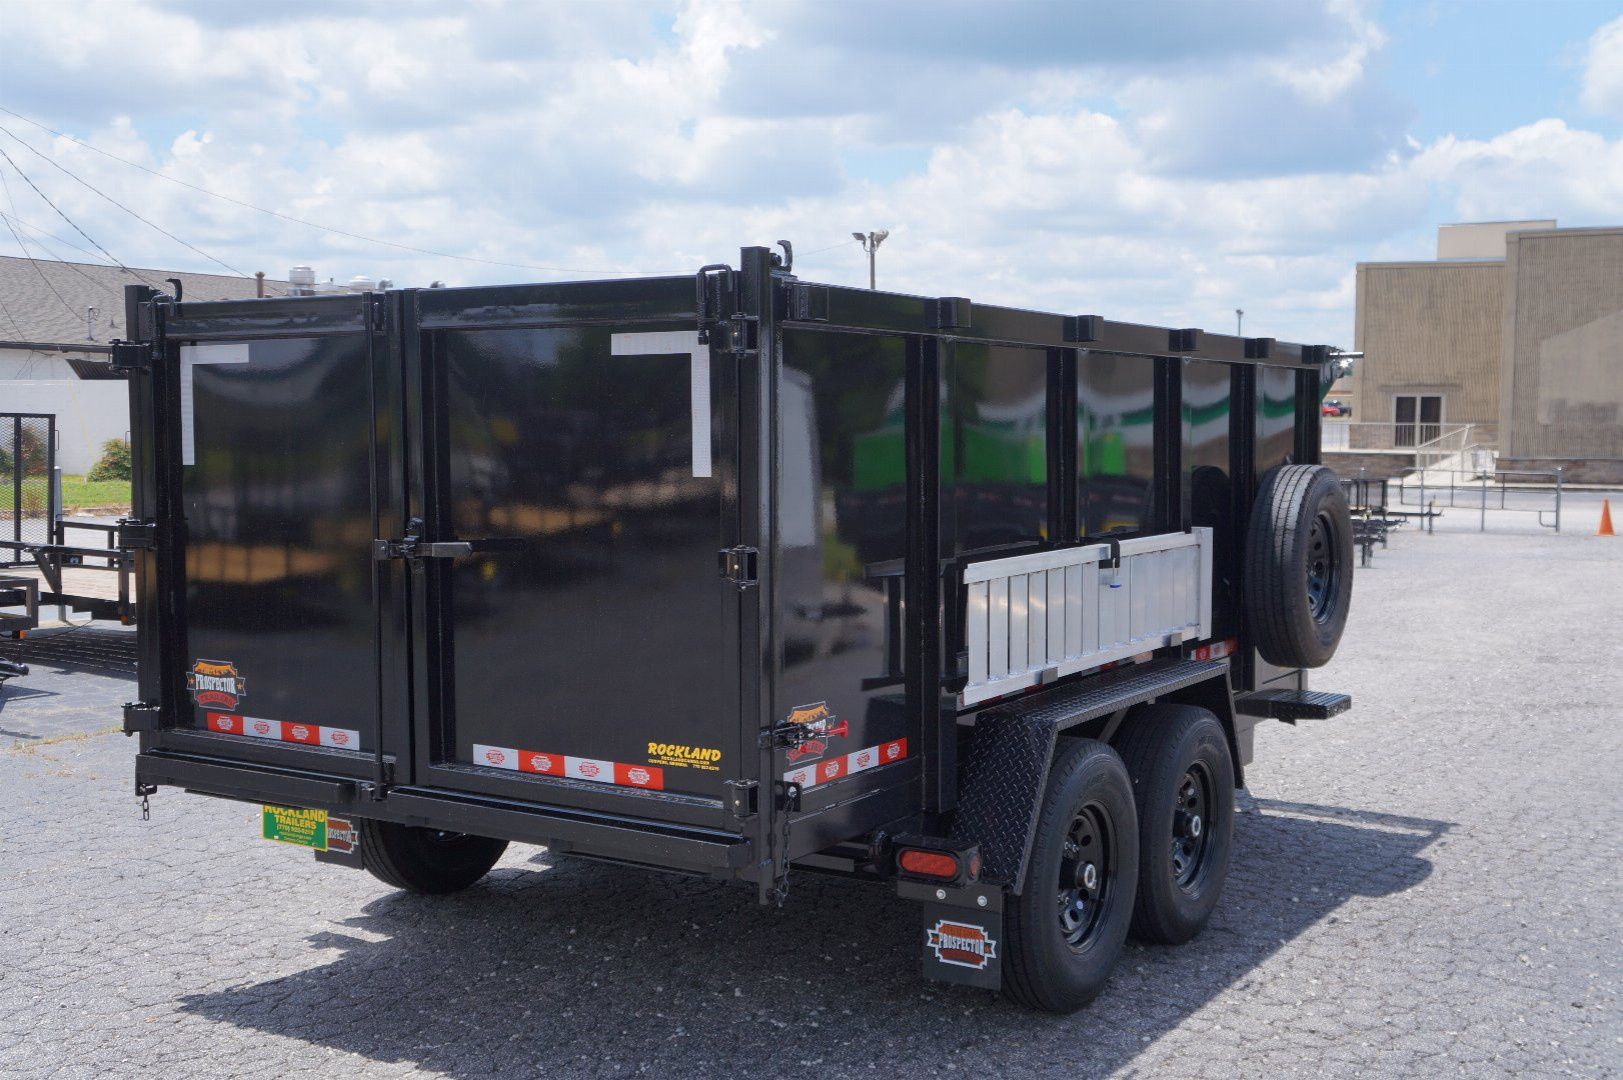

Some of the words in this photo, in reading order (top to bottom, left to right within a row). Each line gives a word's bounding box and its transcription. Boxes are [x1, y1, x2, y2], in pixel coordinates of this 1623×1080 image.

[195, 673, 236, 694] PROSPECTOR
[648, 742, 722, 761] ROCKLAND
[274, 815, 317, 830] TRAILERS
[939, 933, 985, 956] PROSPECTOR
